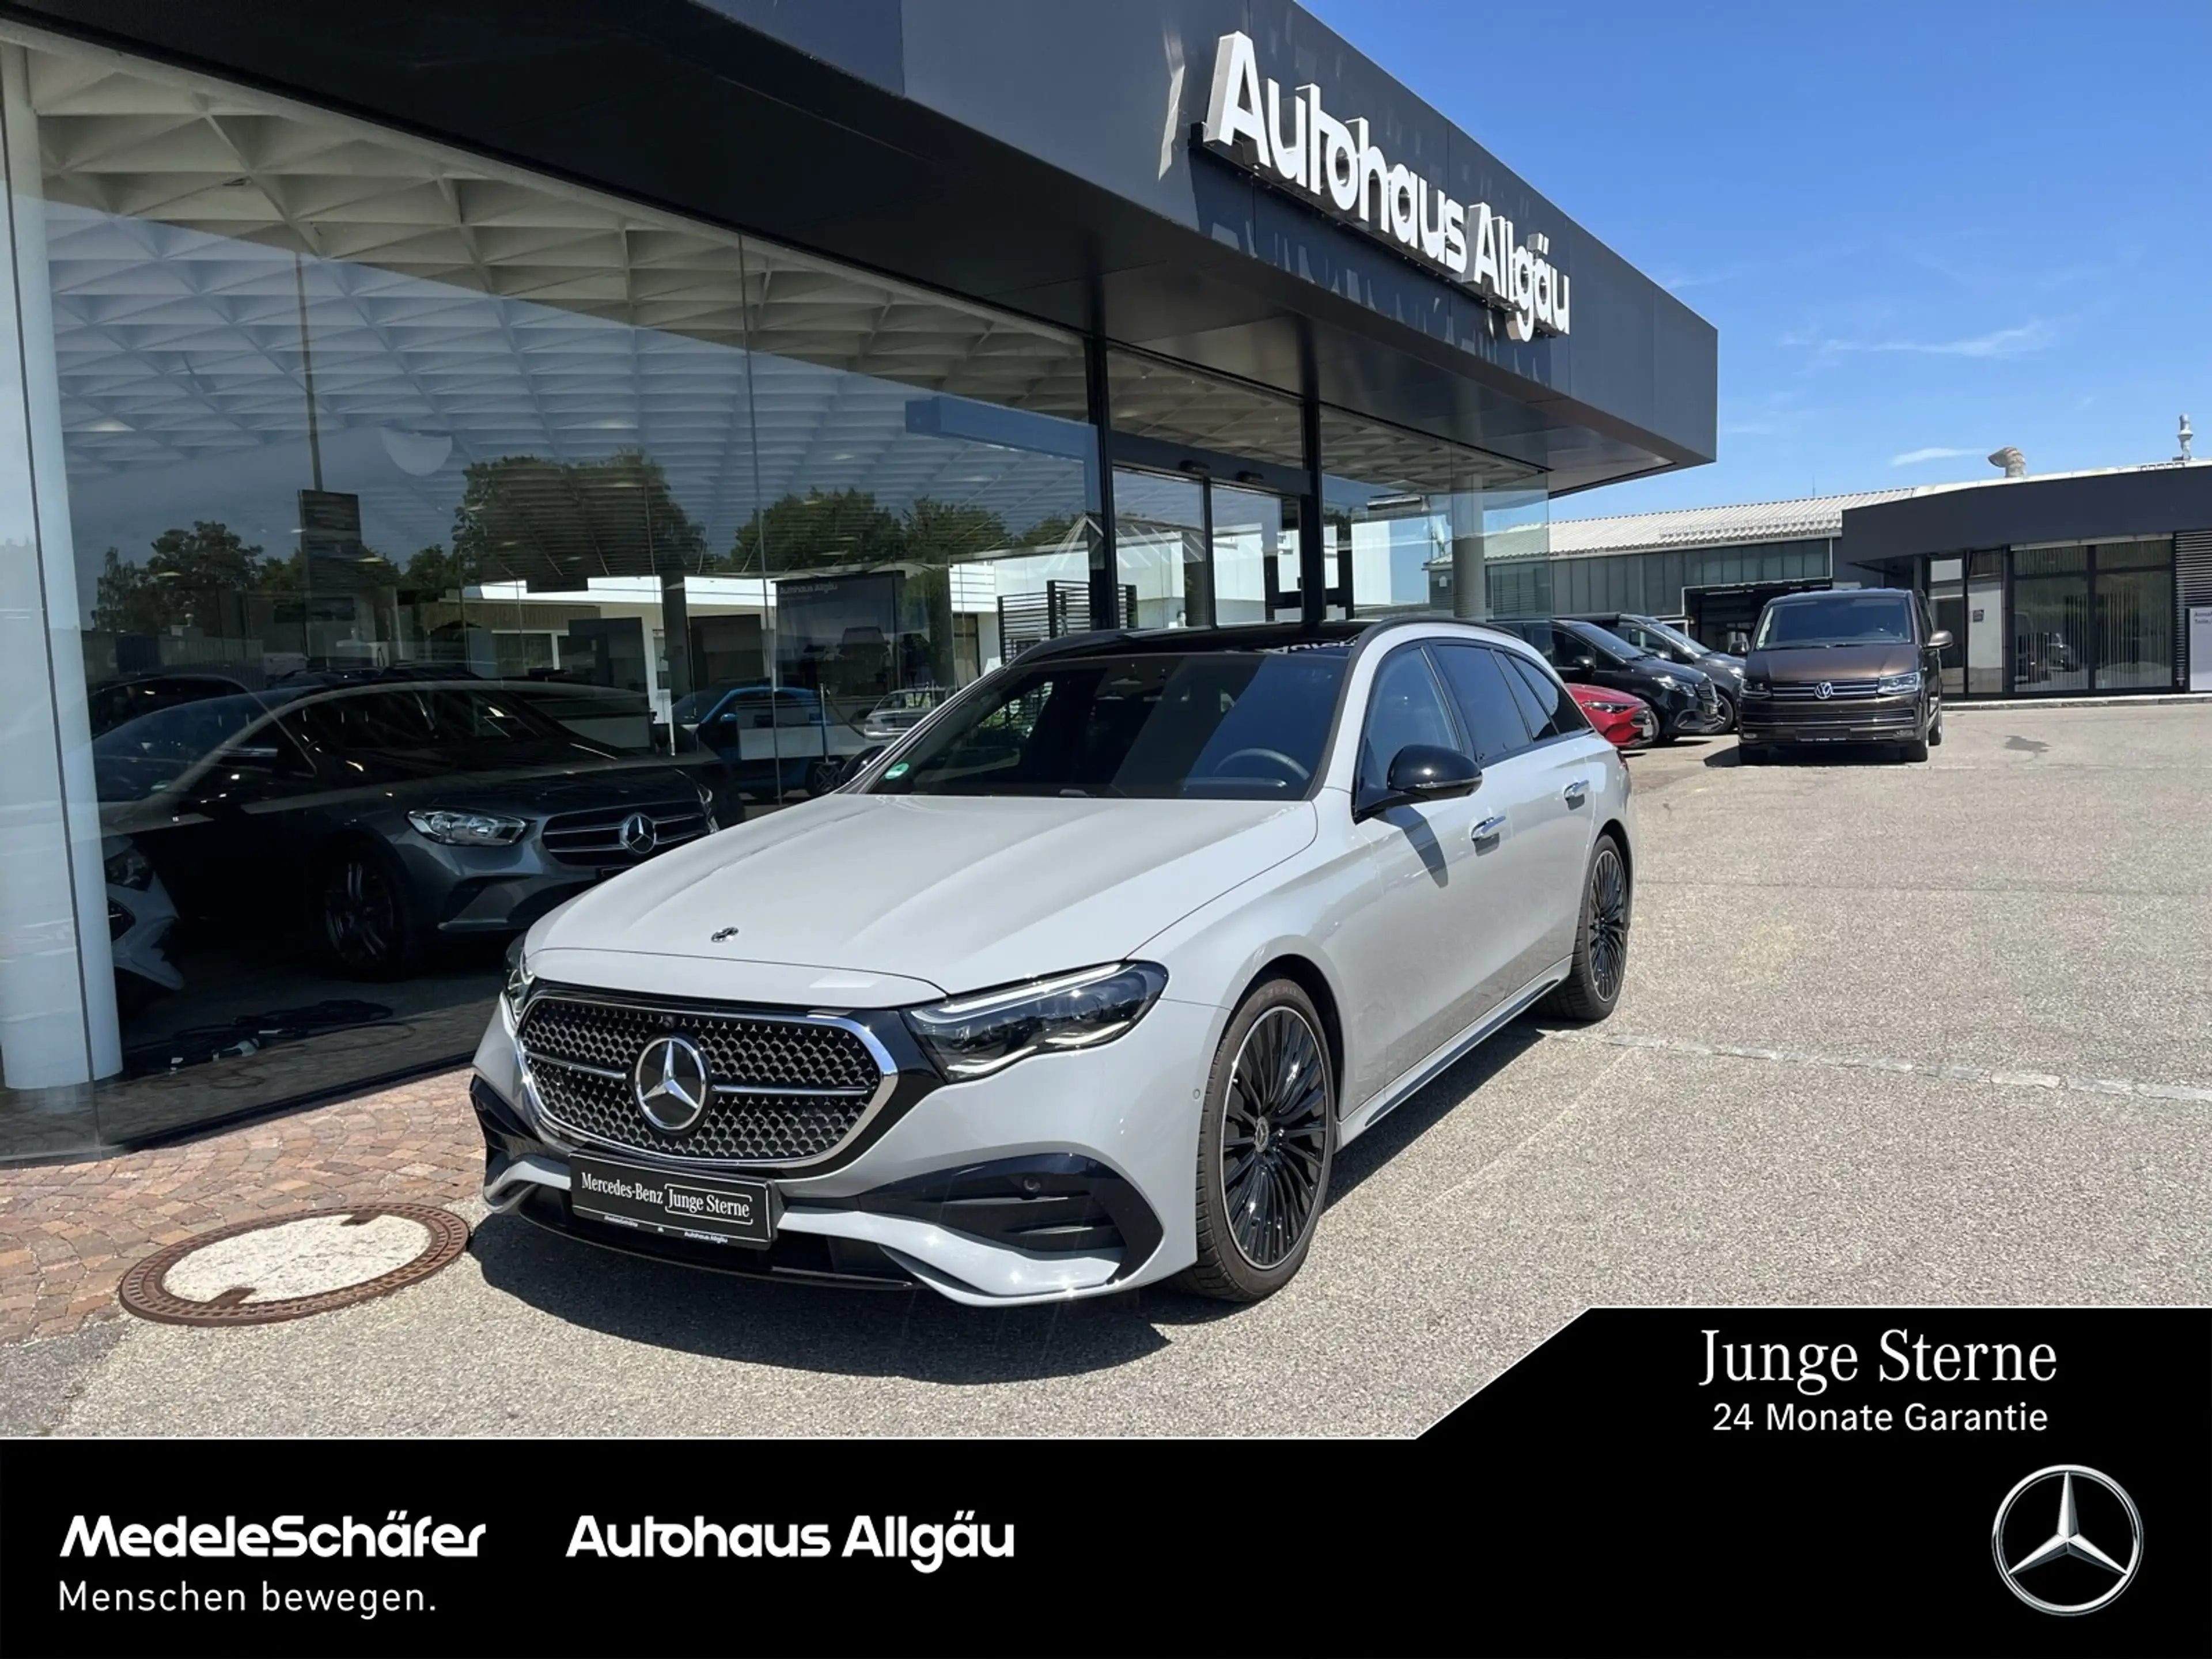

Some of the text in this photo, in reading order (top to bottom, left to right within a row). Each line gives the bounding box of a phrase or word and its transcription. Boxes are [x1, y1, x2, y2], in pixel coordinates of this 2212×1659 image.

[1204, 31, 1570, 343] Autohaus Allgäu
[581, 1172, 750, 1218] Mercedes-Benz Junge Sterne
